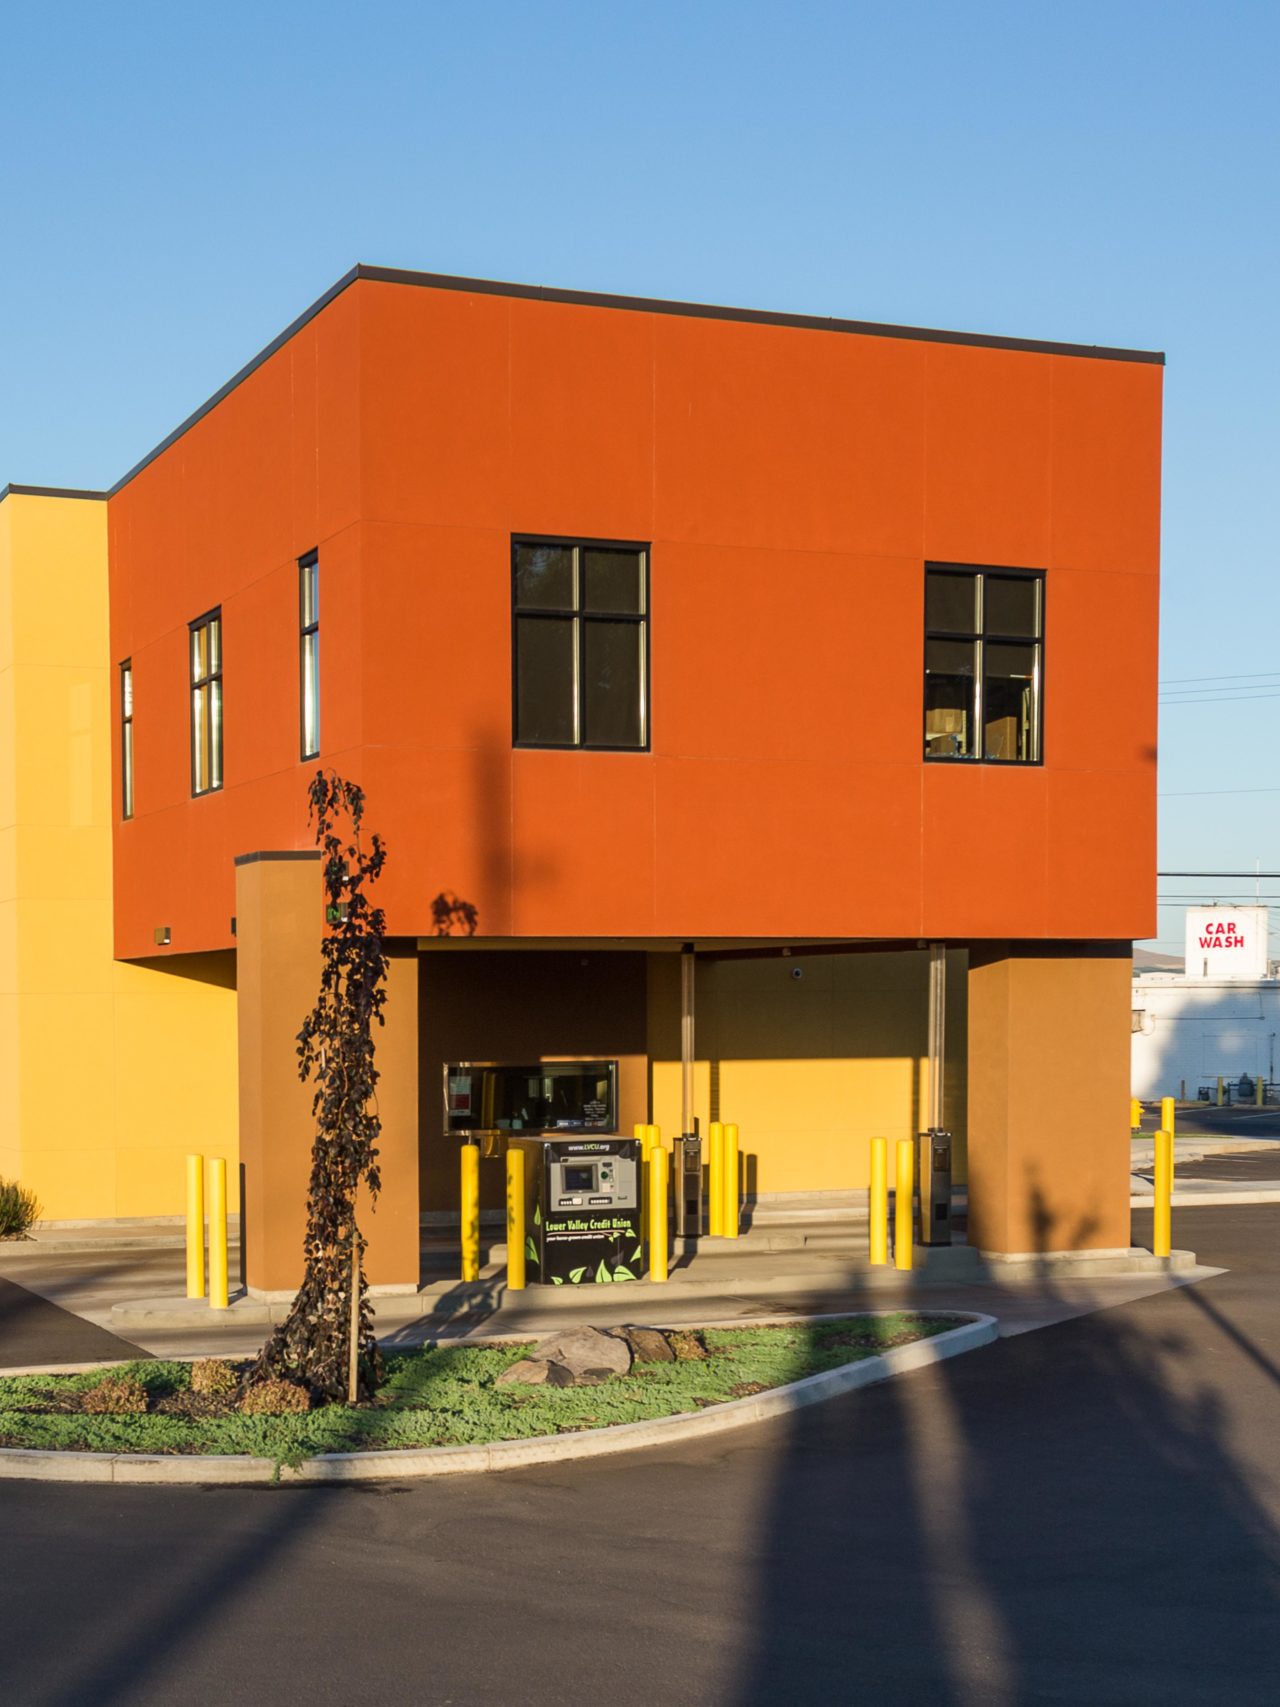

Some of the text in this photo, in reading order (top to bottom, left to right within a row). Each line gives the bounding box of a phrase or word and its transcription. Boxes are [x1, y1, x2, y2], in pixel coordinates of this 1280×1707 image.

[1205, 922, 1236, 935] CAR
[1198, 936, 1244, 949] WASH
[568, 1143, 610, 1152] www.LVCU.org
[545, 1218, 631, 1231] Lower Valley Credit Union
